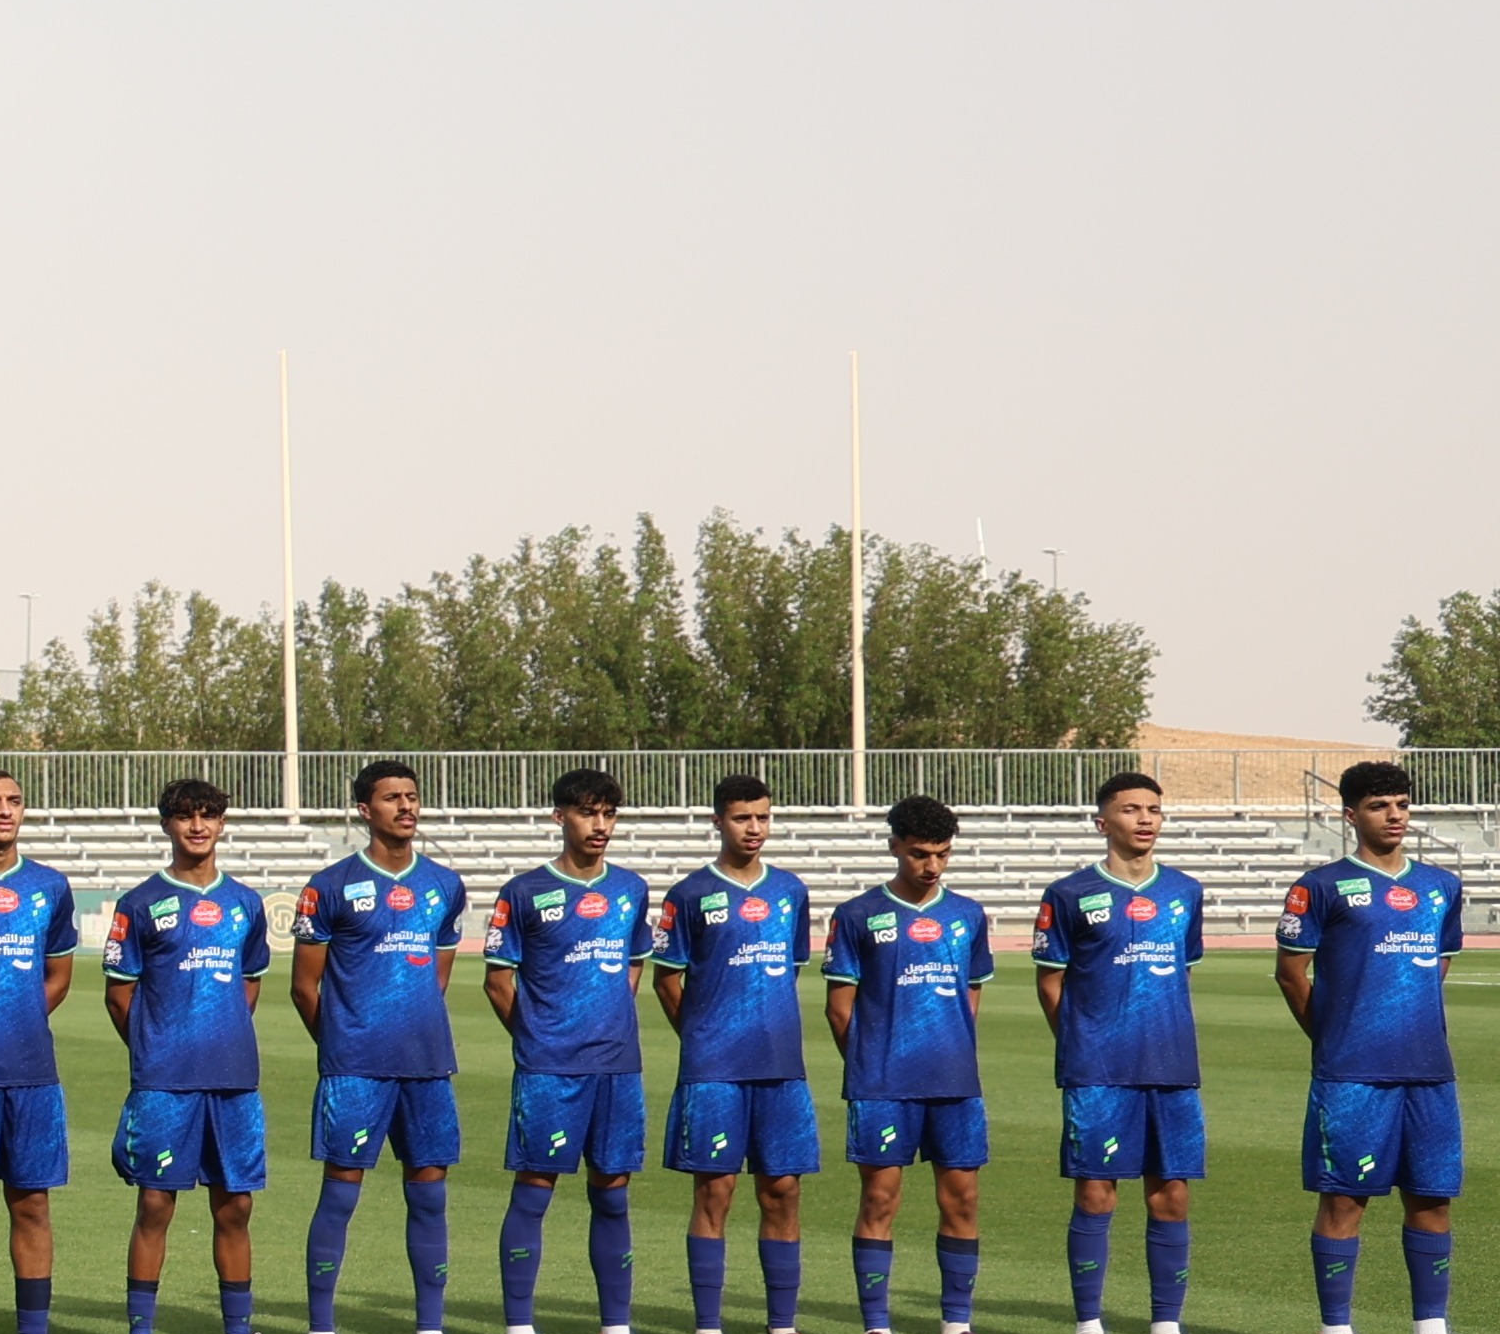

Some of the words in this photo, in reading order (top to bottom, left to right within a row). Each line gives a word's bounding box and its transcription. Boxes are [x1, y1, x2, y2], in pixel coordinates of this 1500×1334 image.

[1374, 942, 1401, 954] aljabr
[1139, 952, 1176, 963] finance
[179, 959, 204, 971] aljabr
